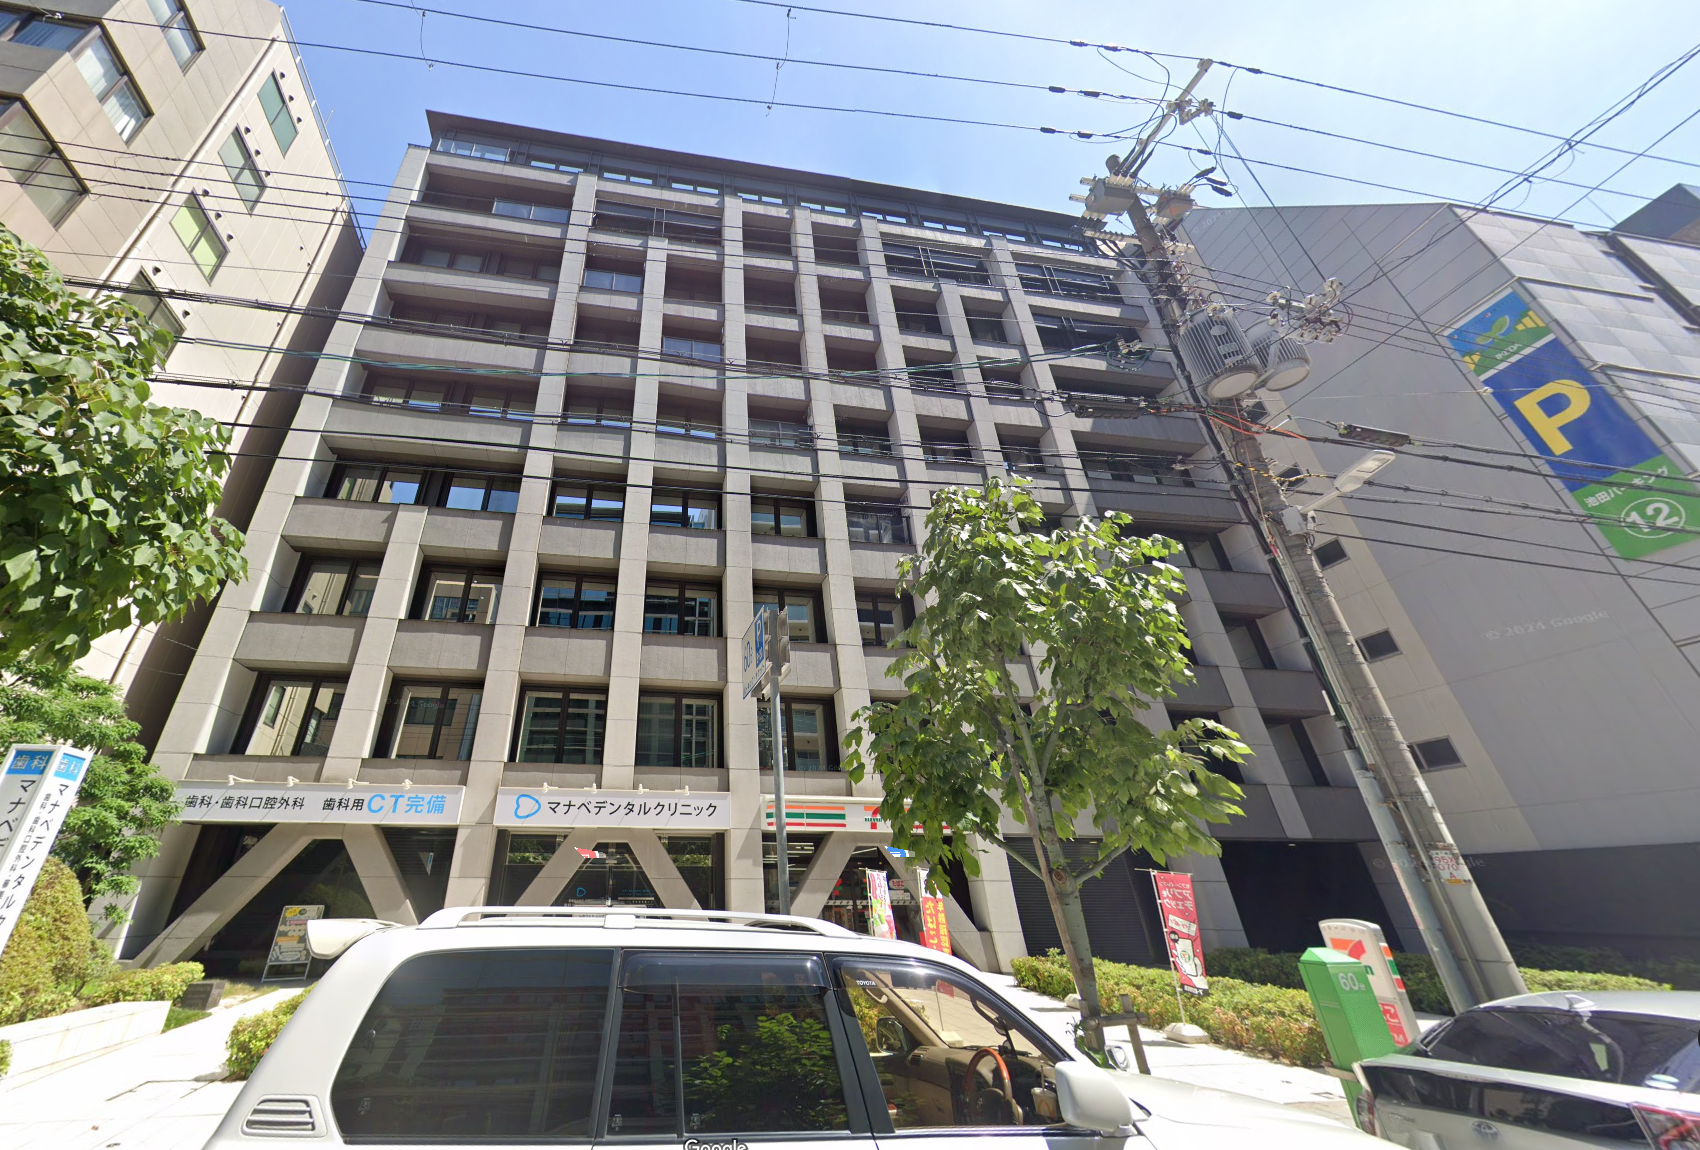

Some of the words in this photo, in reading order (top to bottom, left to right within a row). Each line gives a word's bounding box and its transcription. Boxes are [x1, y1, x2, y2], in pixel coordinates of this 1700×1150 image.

[1514, 379, 1591, 456] P
[1625, 502, 1680, 532] 12
[11, 754, 48, 770] 歯科
[57, 758, 81, 777] 歯科
[184, 795, 305, 811] 歯科・歯科口腔外科
[547, 799, 718, 818] マナベデンタルクリニック
